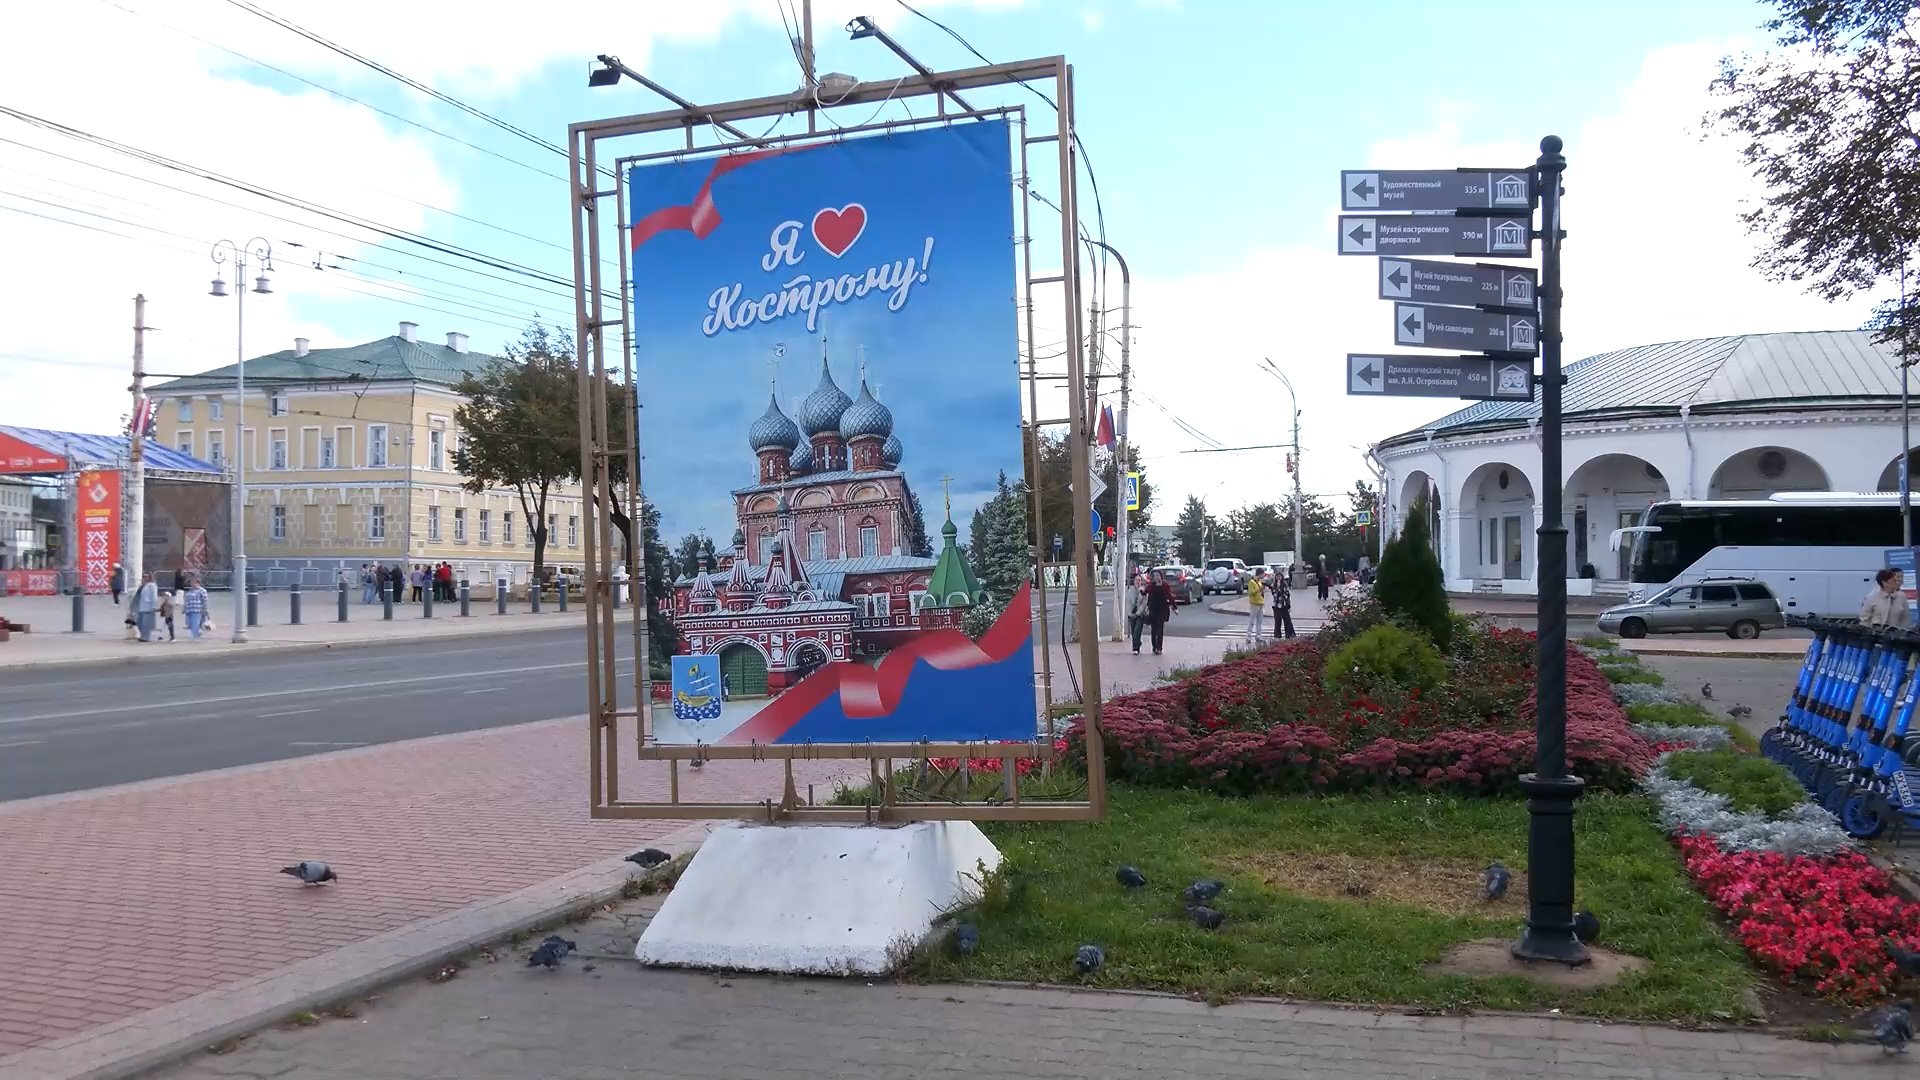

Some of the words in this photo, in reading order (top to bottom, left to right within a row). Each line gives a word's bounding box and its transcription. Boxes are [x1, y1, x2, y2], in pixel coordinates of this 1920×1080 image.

[1383, 180, 1441, 190] Художественный
[1464, 186, 1478, 194] 335
[1383, 191, 1405, 200] музей
[1380, 225, 1402, 234] Музей
[1403, 226, 1450, 234] костромского
[1462, 231, 1476, 239] 390
[1380, 237, 1421, 245] дворянства
[761, 220, 805, 272] Я
[1414, 270, 1433, 280] Музей
[1434, 273, 1473, 283] театрального
[702, 237, 934, 337] Кострому!
[1481, 282, 1493, 290] 225
[1427, 322, 1444, 332] Музей
[1489, 328, 1499, 336] 200
[1388, 365, 1442, 375] Драматический
[1443, 367, 1462, 376] театр
[1416, 377, 1458, 386] Островского
[1467, 373, 1480, 381] 450
